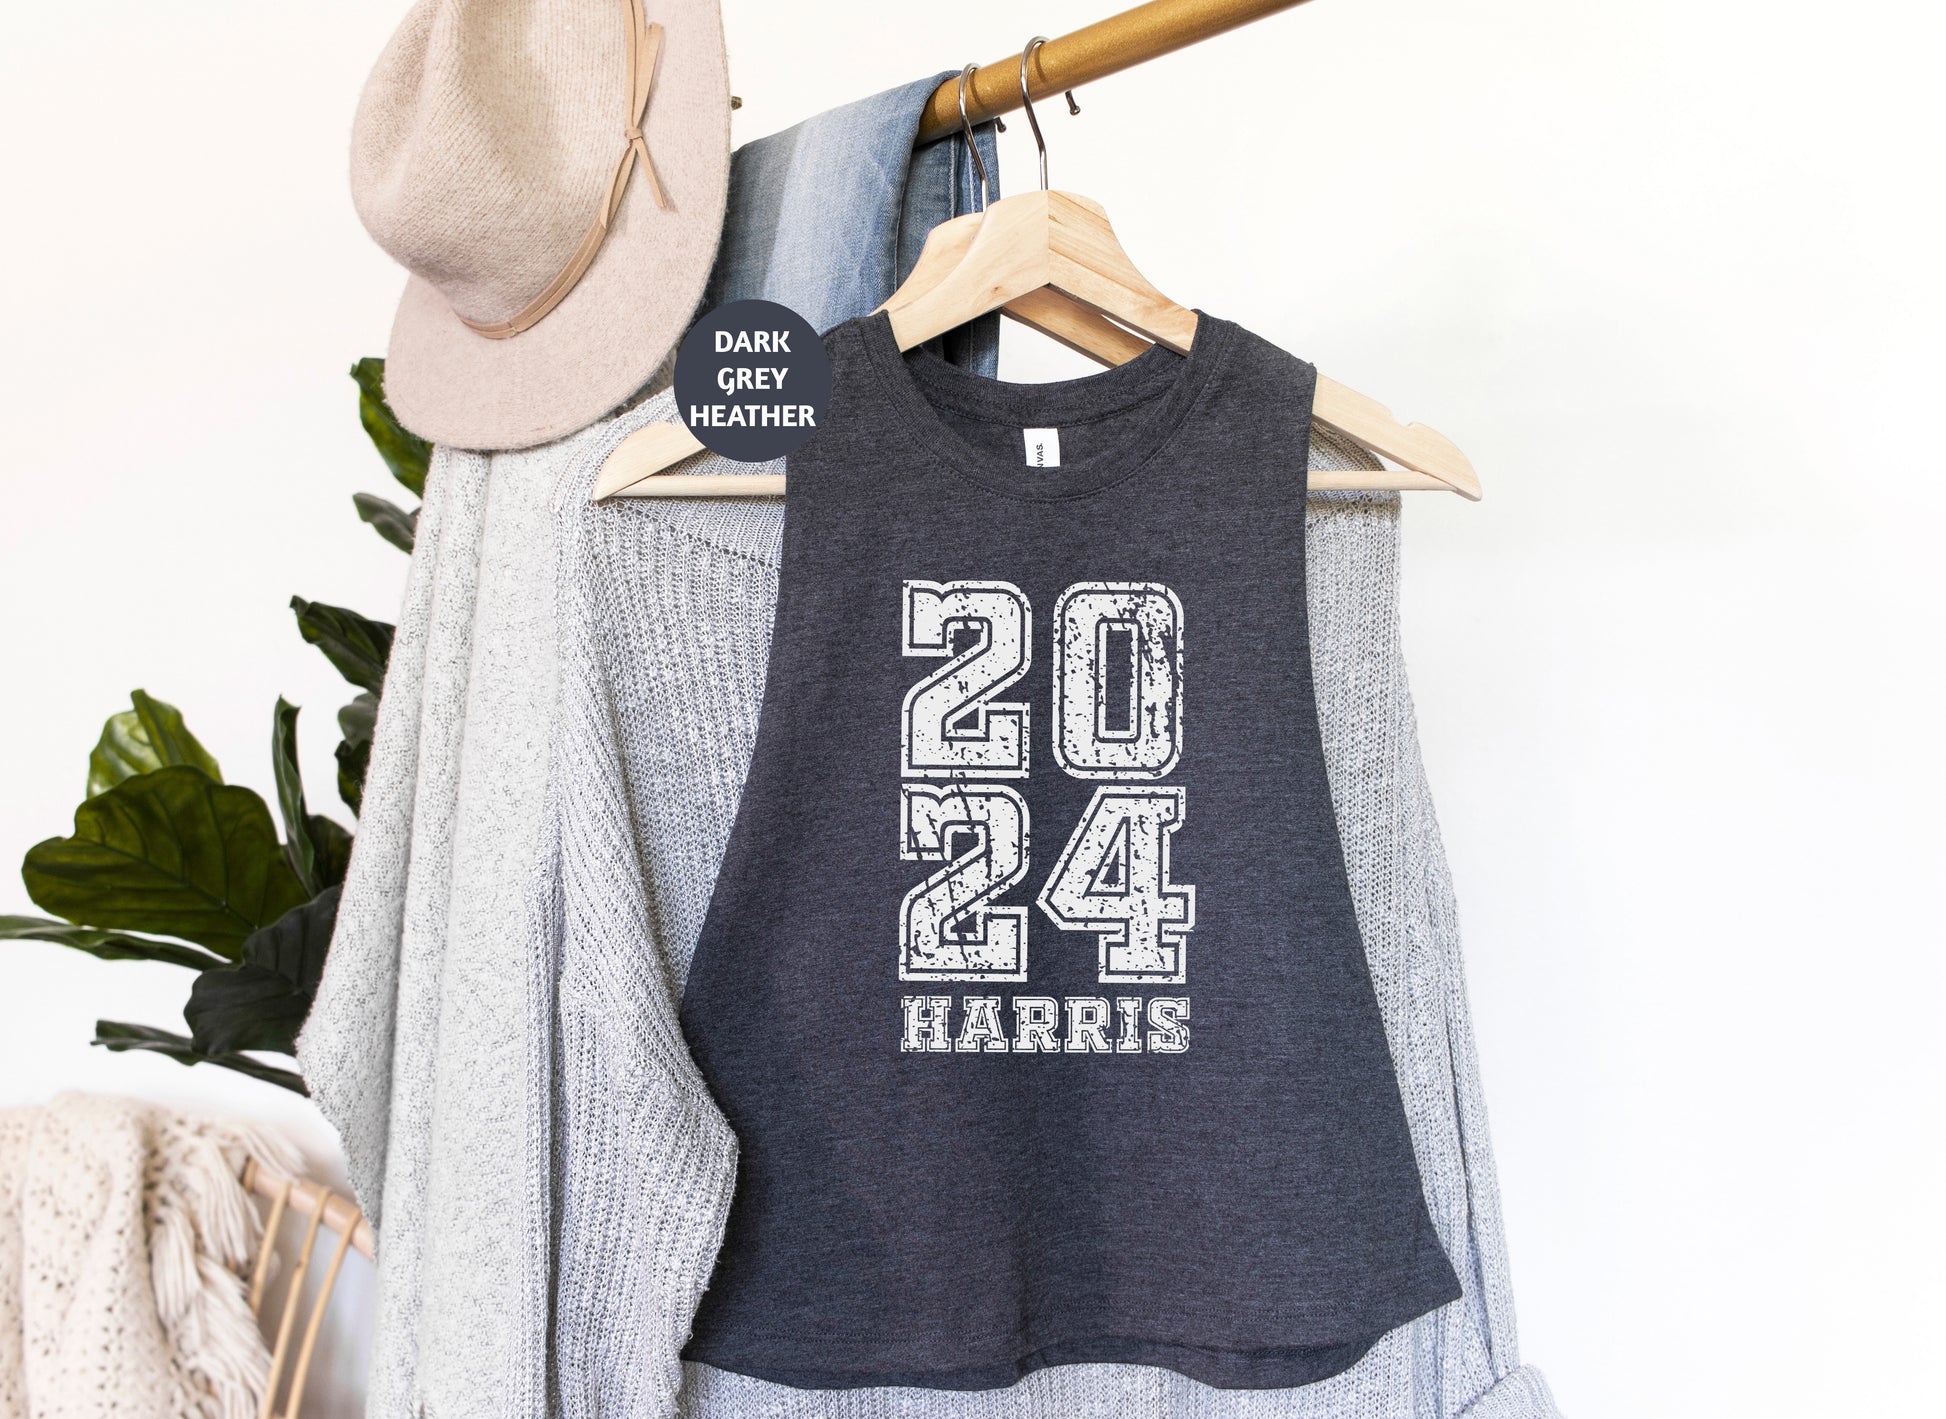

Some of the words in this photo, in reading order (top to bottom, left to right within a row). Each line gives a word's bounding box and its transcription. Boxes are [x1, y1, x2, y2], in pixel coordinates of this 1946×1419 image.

[901, 580, 1185, 780] 20
[899, 784, 1196, 984] 24
[900, 996, 1191, 1054] HARRIS
